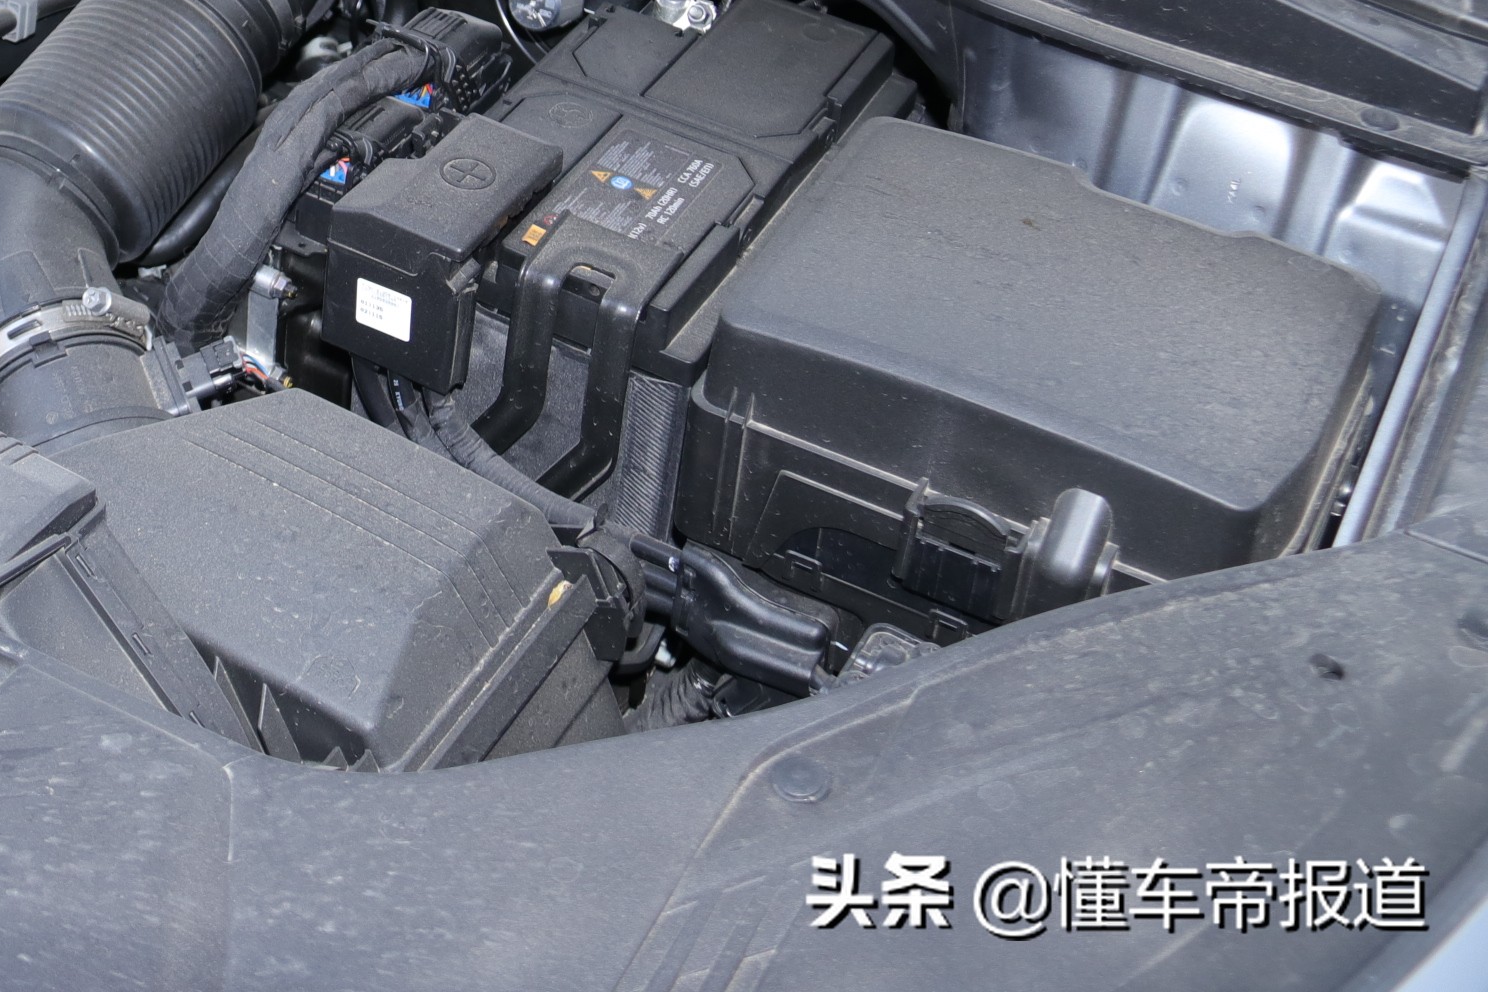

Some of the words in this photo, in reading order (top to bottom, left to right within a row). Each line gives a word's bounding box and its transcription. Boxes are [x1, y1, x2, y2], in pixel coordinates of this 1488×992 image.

[645, 205, 662, 220] 70Ah
[657, 187, 679, 206] (20HR)
[677, 172, 692, 184] CCA
[656, 215, 670, 225] RC
[664, 197, 685, 216] 120min
